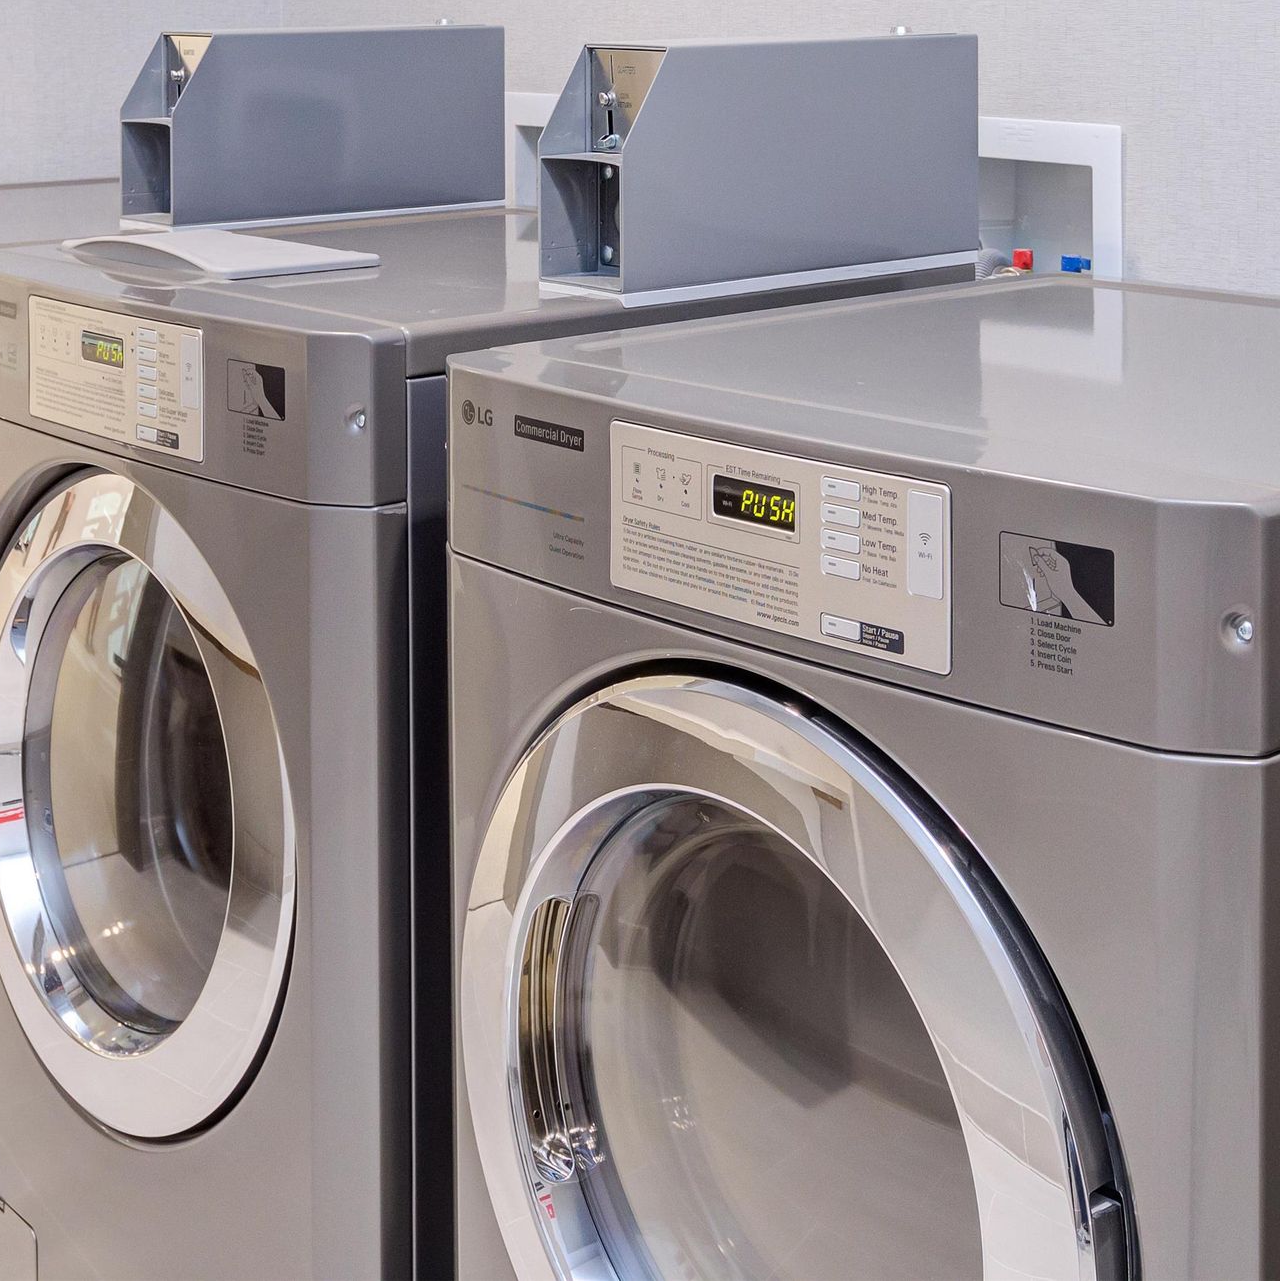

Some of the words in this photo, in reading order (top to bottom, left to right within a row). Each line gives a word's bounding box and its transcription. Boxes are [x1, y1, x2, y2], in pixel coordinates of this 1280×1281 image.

[478, 409, 493, 426] LG
[516, 420, 559, 442] Commercial
[560, 430, 582, 447] Dryer
[647, 448, 675, 462] Processing
[751, 470, 781, 485] Remaining
[862, 485, 877, 499] High
[740, 489, 795, 522] PUSH
[862, 511, 876, 522] Med
[862, 538, 876, 548] Low
[917, 551, 933, 561] Wi-Fi
[862, 564, 872, 574] No
[872, 567, 889, 578] Heat
[862, 625, 877, 635] Start
[881, 627, 899, 640] Pause
[1037, 619, 1053, 629] Load
[1054, 622, 1082, 634] Machine
[1056, 633, 1071, 643] Door
[1037, 640, 1058, 652] Select
[1059, 644, 1077, 655] Cycle
[1037, 650, 1056, 661] Insert
[1057, 654, 1072, 664] Coin
[1037, 661, 1055, 671] Press
[1057, 665, 1073, 675] Start
